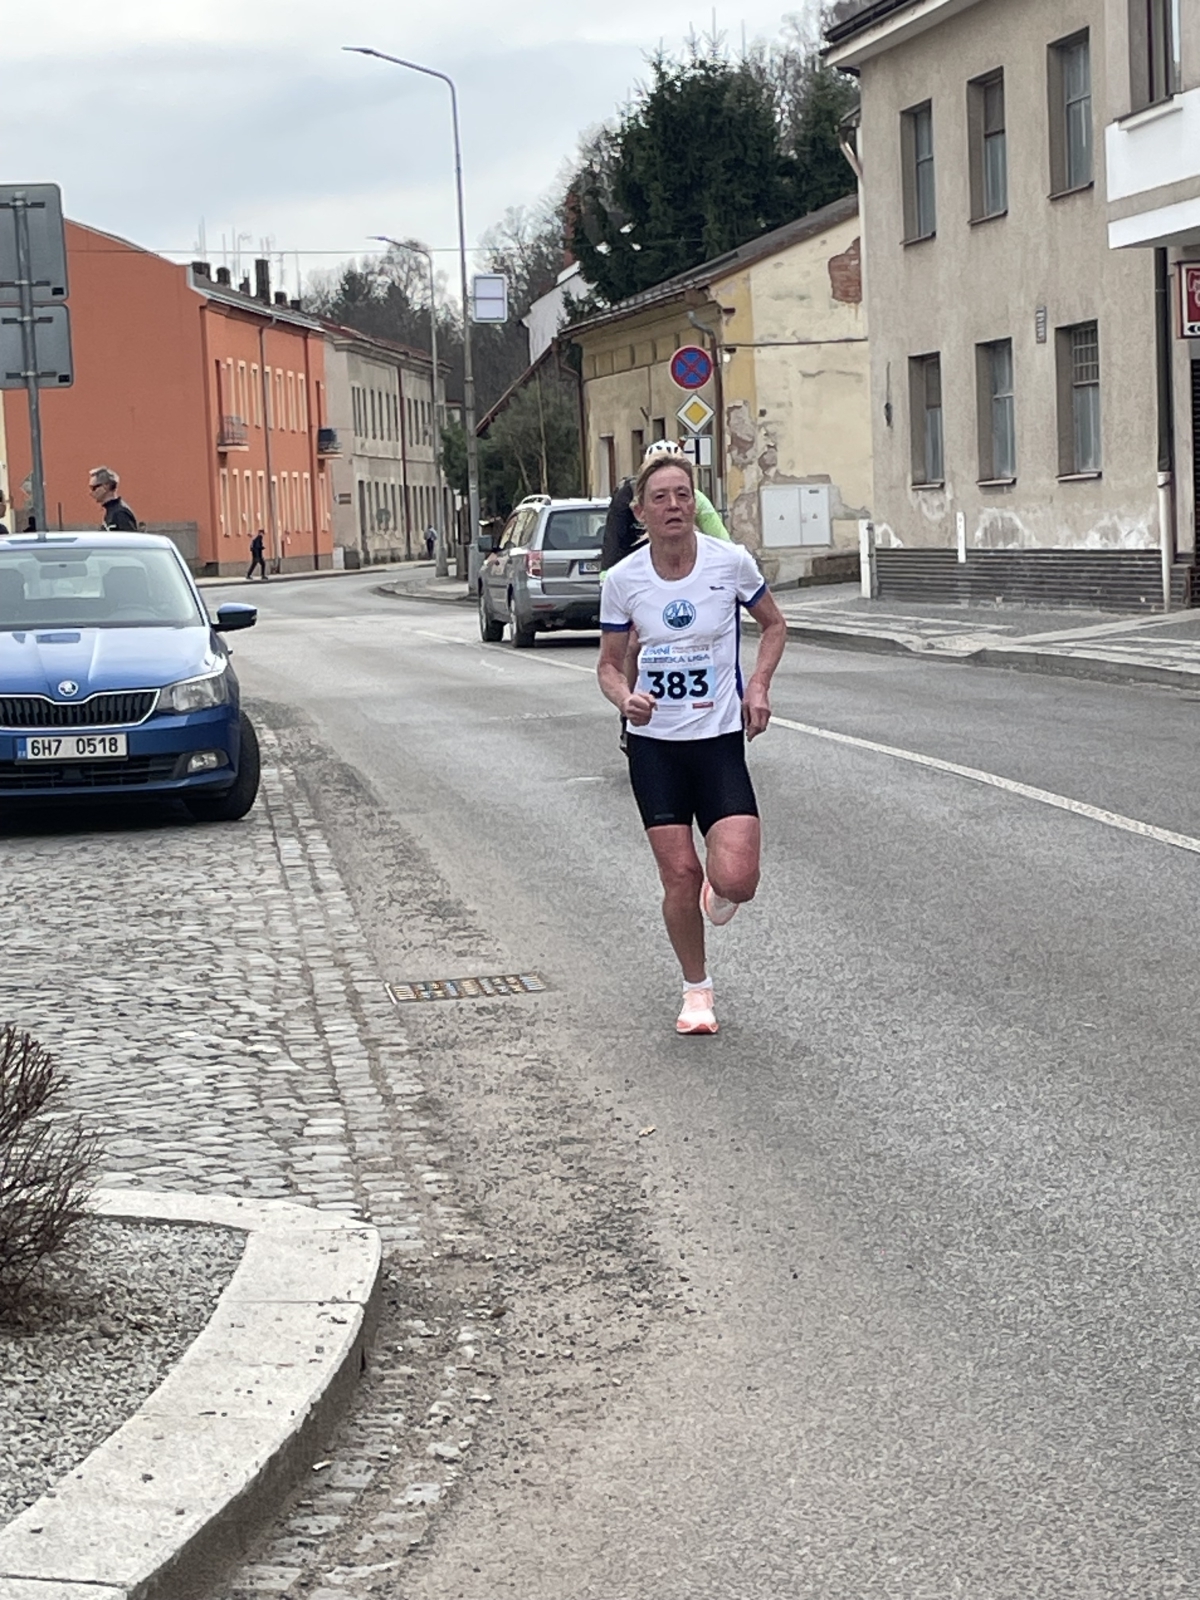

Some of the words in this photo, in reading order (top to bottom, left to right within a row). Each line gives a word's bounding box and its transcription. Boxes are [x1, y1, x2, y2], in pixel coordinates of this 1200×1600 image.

[647, 669, 709, 700] 383
[31, 739, 62, 756] 6H7
[76, 737, 118, 755] 0518
